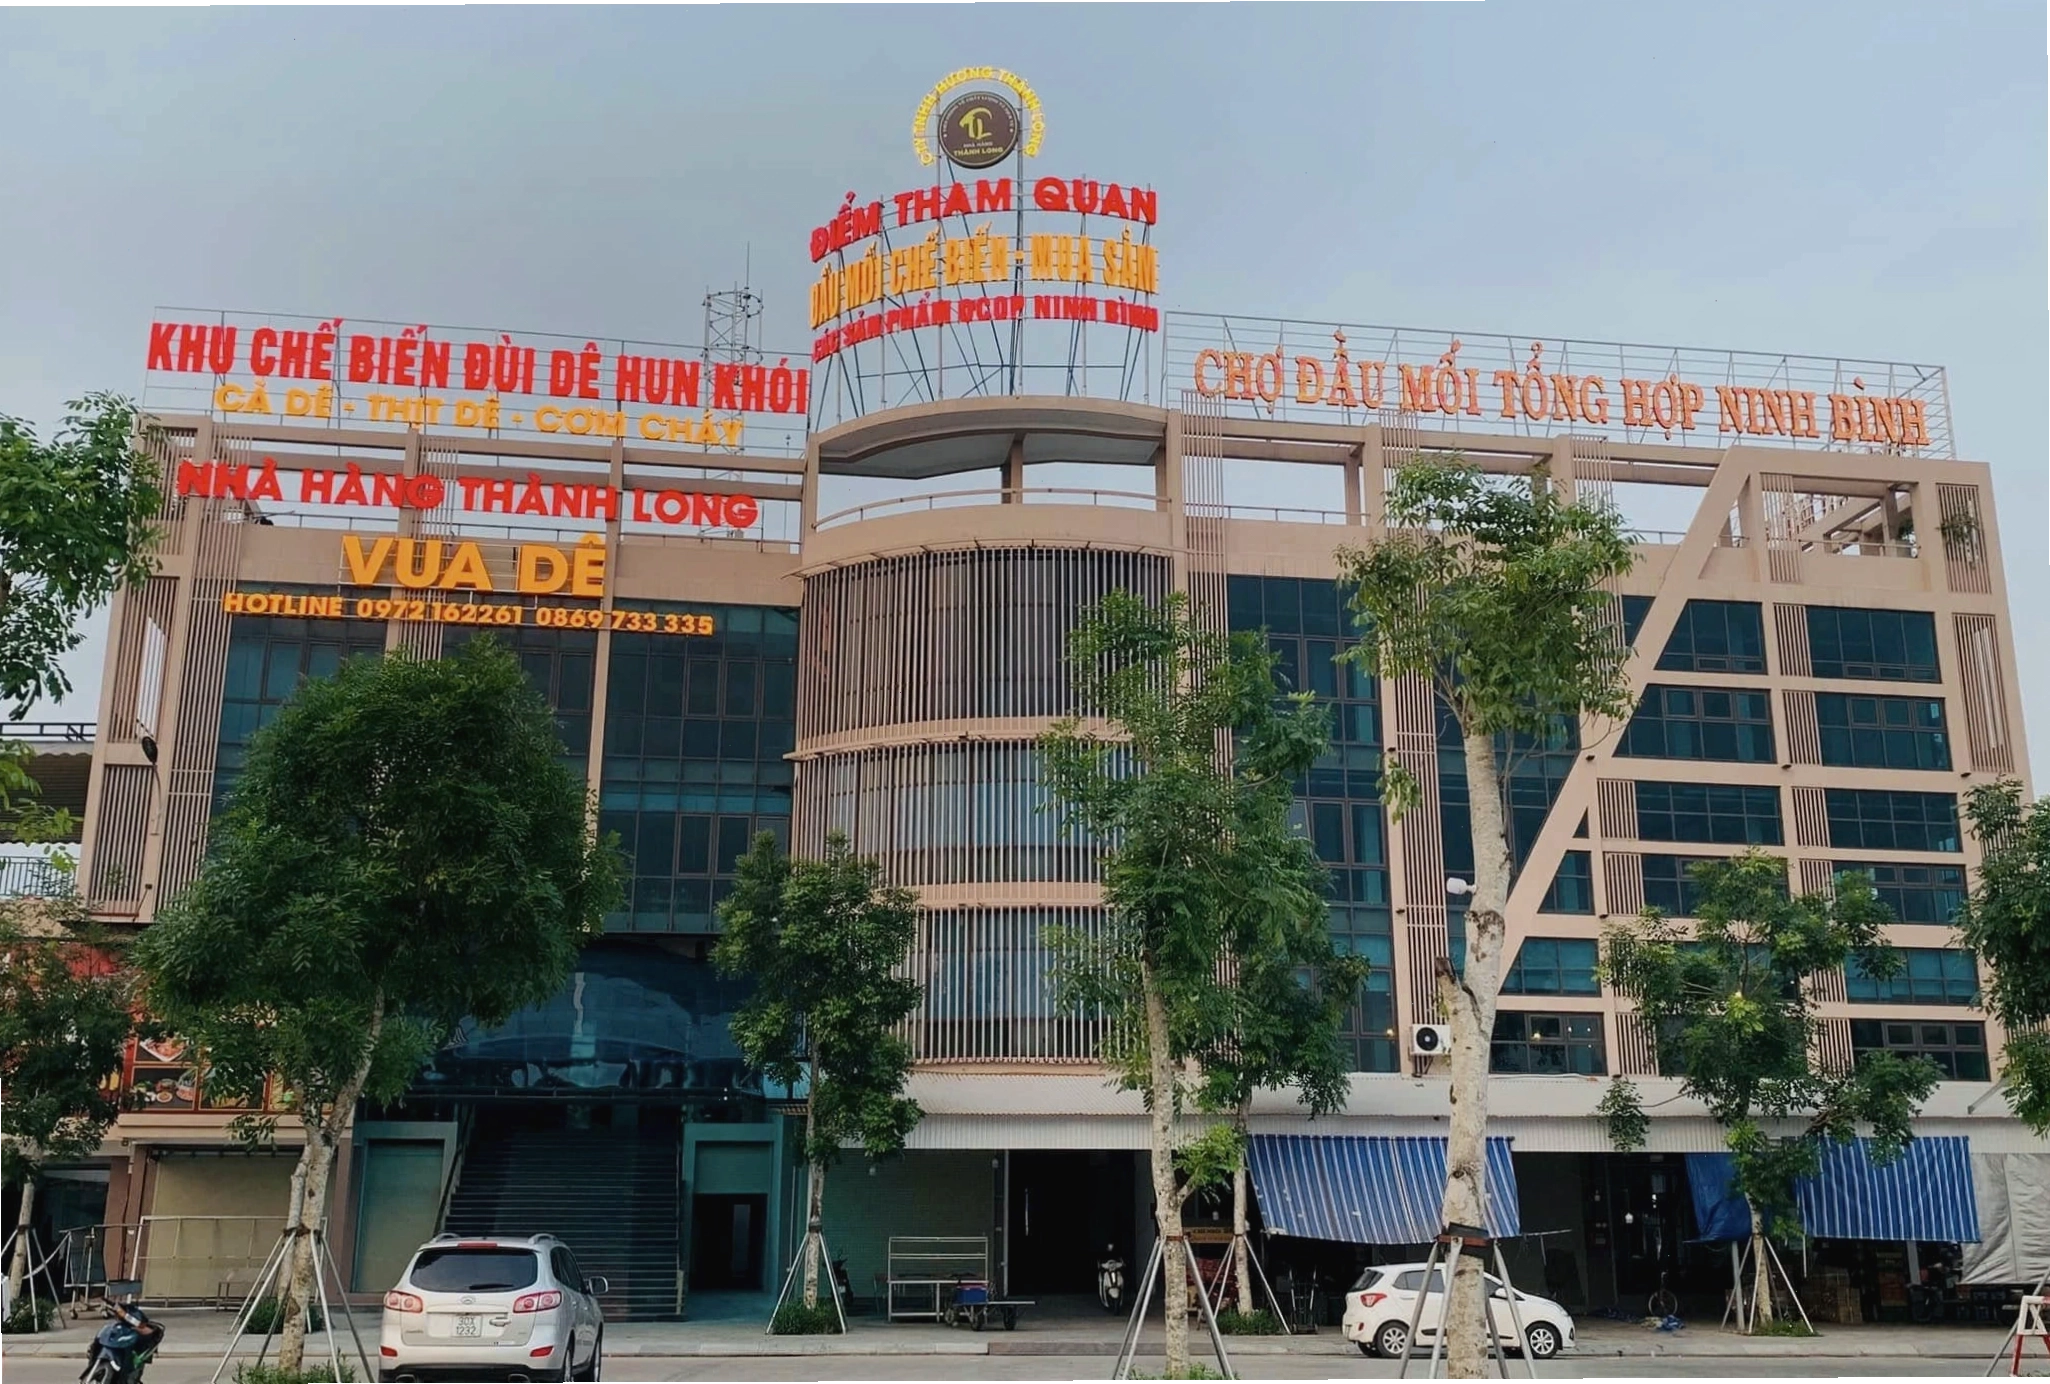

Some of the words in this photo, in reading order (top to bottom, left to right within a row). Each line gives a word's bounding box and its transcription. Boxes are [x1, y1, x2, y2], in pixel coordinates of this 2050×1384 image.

[981, 146, 1003, 154] LONG
[1023, 112, 1045, 158] LONG
[810, 191, 882, 263] ĐIỂM
[894, 178, 1012, 227] THAM
[1033, 176, 1157, 226] QUAN
[889, 225, 940, 295] CHẾ
[944, 222, 1009, 285] BIẾN
[1031, 233, 1094, 283] MUA
[843, 310, 883, 346] SẢN
[885, 291, 952, 334] PHẨM
[1033, 295, 1098, 321] NINH
[1104, 296, 1159, 332] BÌNH
[147, 322, 237, 374] KHU
[250, 318, 343, 381] CHẾ
[349, 324, 450, 389] BIẾN
[463, 335, 536, 395] ĐÙI
[549, 341, 602, 400] DÊ
[616, 354, 701, 408] HUN
[713, 357, 808, 415] KHÓI
[1194, 344, 1284, 414] CHỢ
[1295, 330, 1385, 408] ĐẦU
[1400, 339, 1481, 415] MỐI
[1493, 341, 1609, 424] TỔNG
[1621, 374, 1704, 440] HỢP
[1715, 385, 1820, 438] NINH
[1829, 376, 1930, 445] BÌNH
[285, 384, 333, 419] DÊ
[367, 393, 444, 430] THỊT
[455, 394, 500, 431] DÊ
[533, 405, 627, 438] CƠM
[638, 412, 744, 446] CHÁY
[176, 457, 283, 503] NHÀ
[300, 461, 445, 510] HÀNG
[458, 472, 618, 522] THÀNH
[631, 486, 759, 529] LONG
[341, 535, 494, 592] VUA
[518, 532, 607, 597] DÊ
[223, 592, 343, 618] HOTLINE
[456, 1326, 477, 1335] 1232
